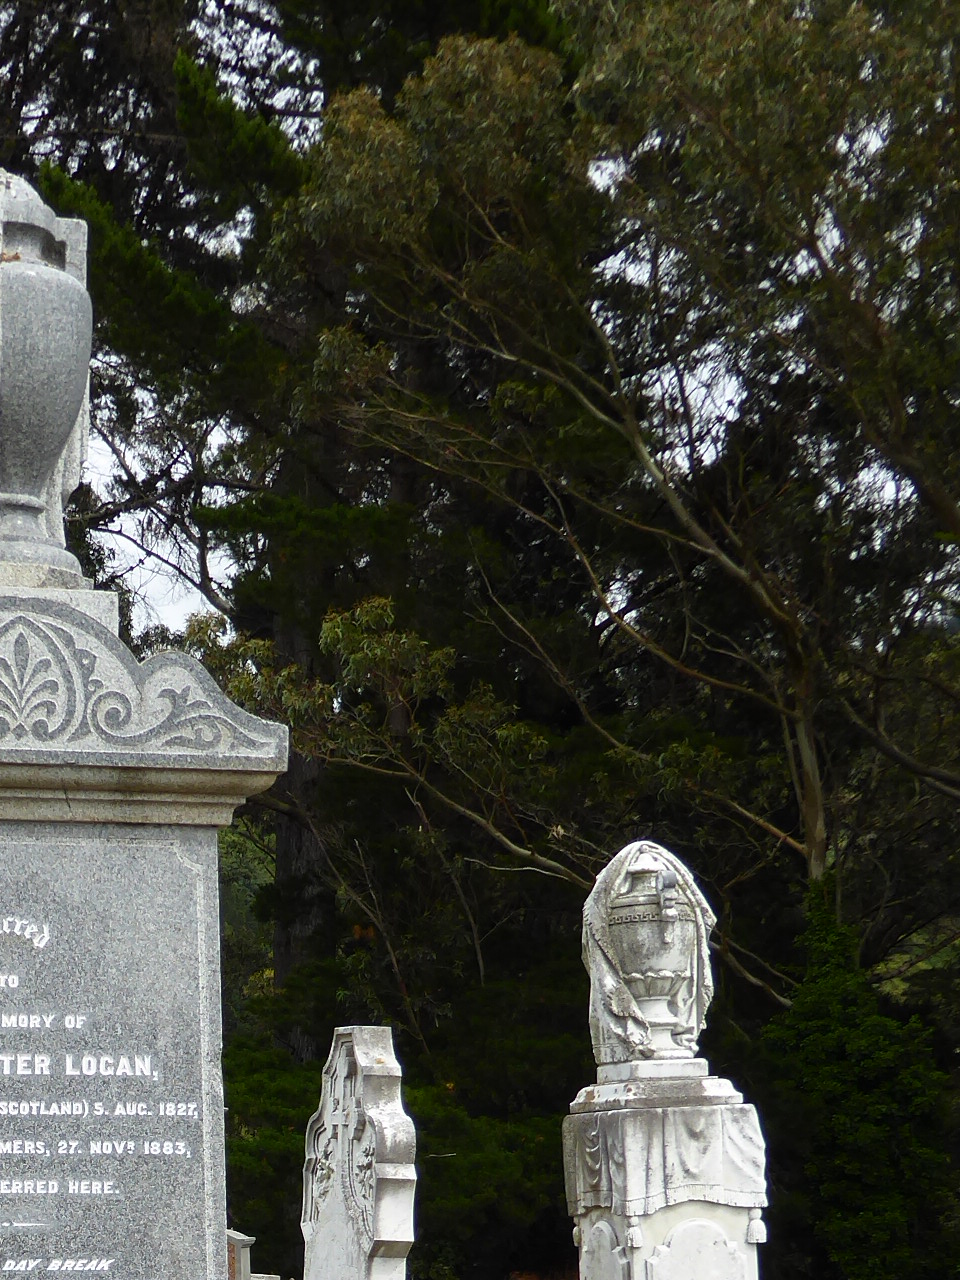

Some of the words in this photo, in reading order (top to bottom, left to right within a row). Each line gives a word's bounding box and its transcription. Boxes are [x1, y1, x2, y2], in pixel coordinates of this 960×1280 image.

[65, 1015, 86, 1028] OF
[65, 1055, 158, 1080] LOGAN,
[94, 1102, 108, 1115] 5.
[114, 1102, 152, 1115] AUG.
[57, 1141, 81, 1154] 27.
[144, 1141, 191, 1158] 1883,
[69, 1180, 119, 1194] HERE.
[2, 1259, 39, 1271] DAY
[46, 1259, 115, 1271] BREAK
